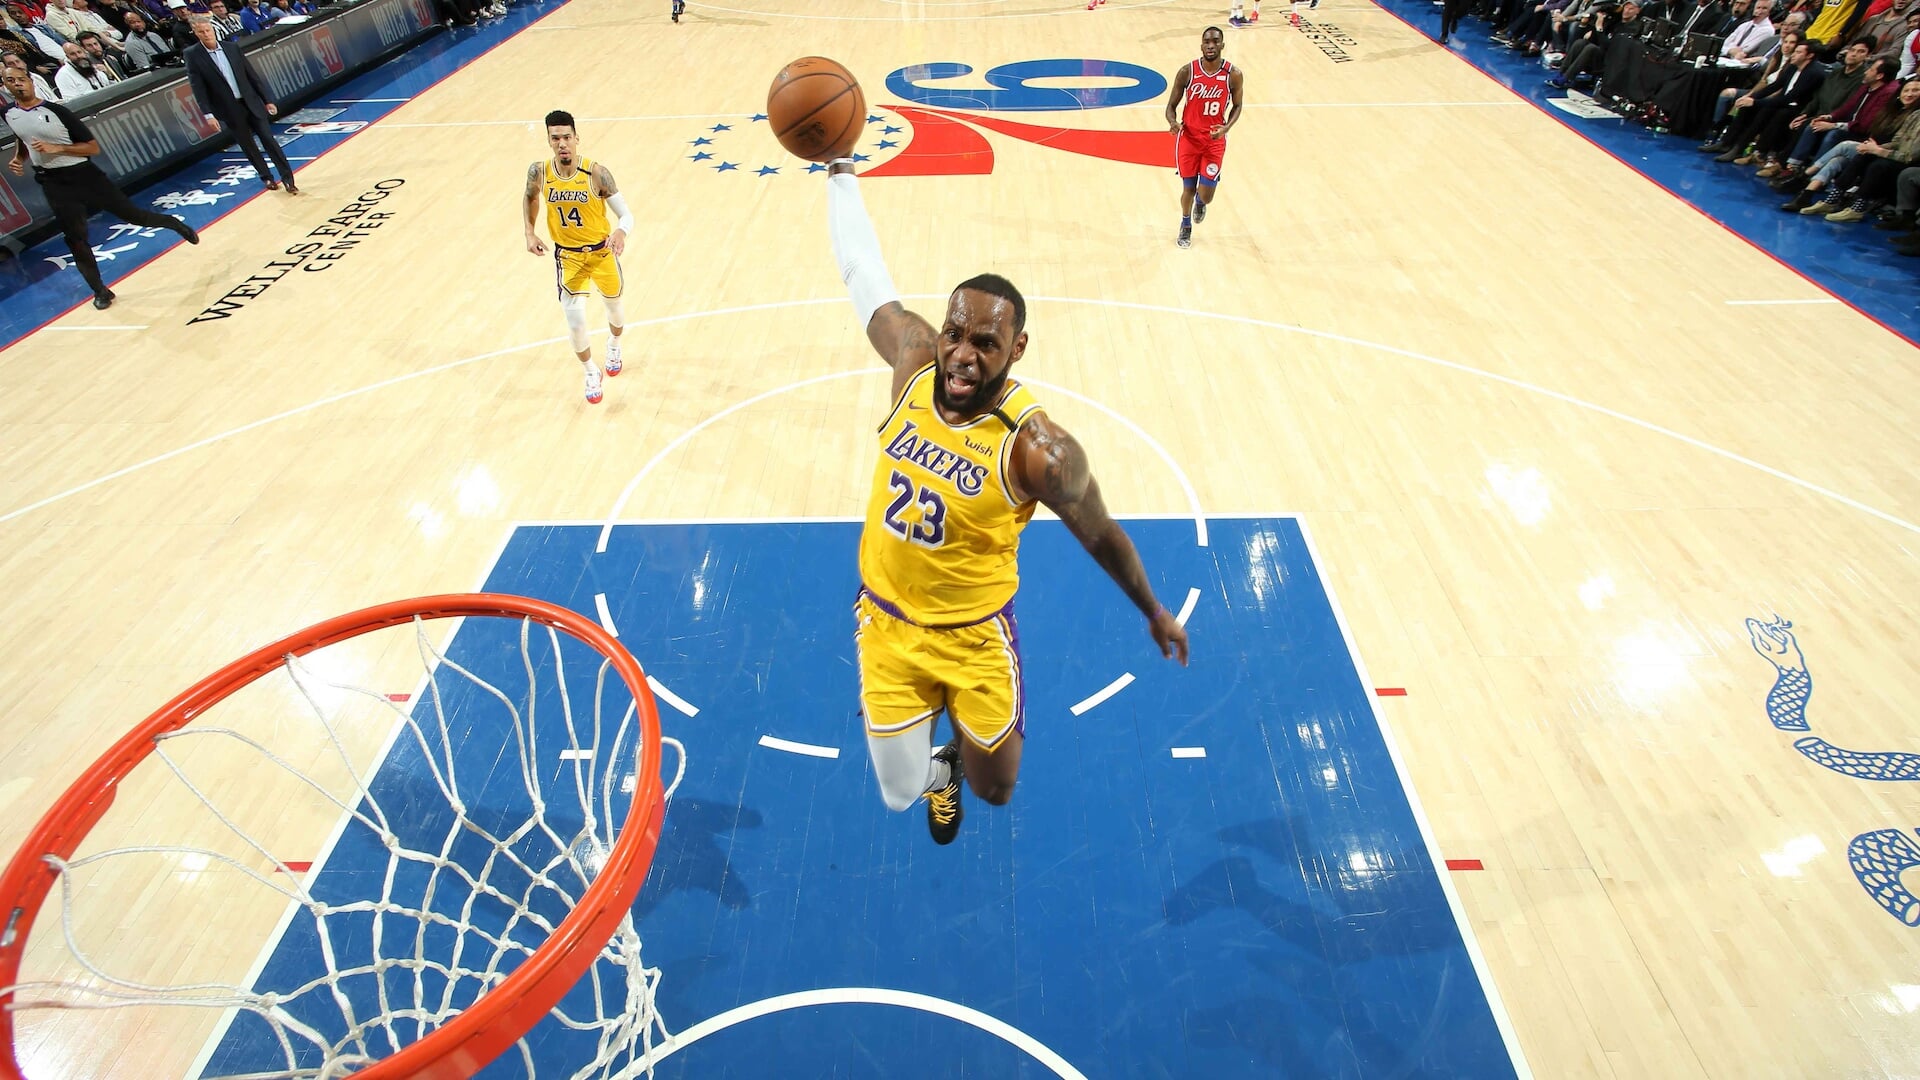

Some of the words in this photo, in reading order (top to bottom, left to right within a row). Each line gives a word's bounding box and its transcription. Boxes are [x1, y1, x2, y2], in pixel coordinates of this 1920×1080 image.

[369, 0, 410, 46] WATCH
[1318, 23, 1358, 46] CENTER
[1306, 35, 1354, 64] WELLS
[257, 41, 314, 100] WATCH
[1190, 82, 1224, 101] Phila
[1203, 101, 1220, 116] 18
[90, 102, 176, 176] WATCH
[547, 187, 589, 204] LAKERS
[557, 205, 584, 228] 14
[185, 242, 323, 326] WELLS
[306, 178, 406, 238] FARGO
[303, 211, 397, 272] CENTER
[884, 419, 991, 496] LAKERS
[964, 434, 994, 457] wish
[882, 467, 948, 550] 23
